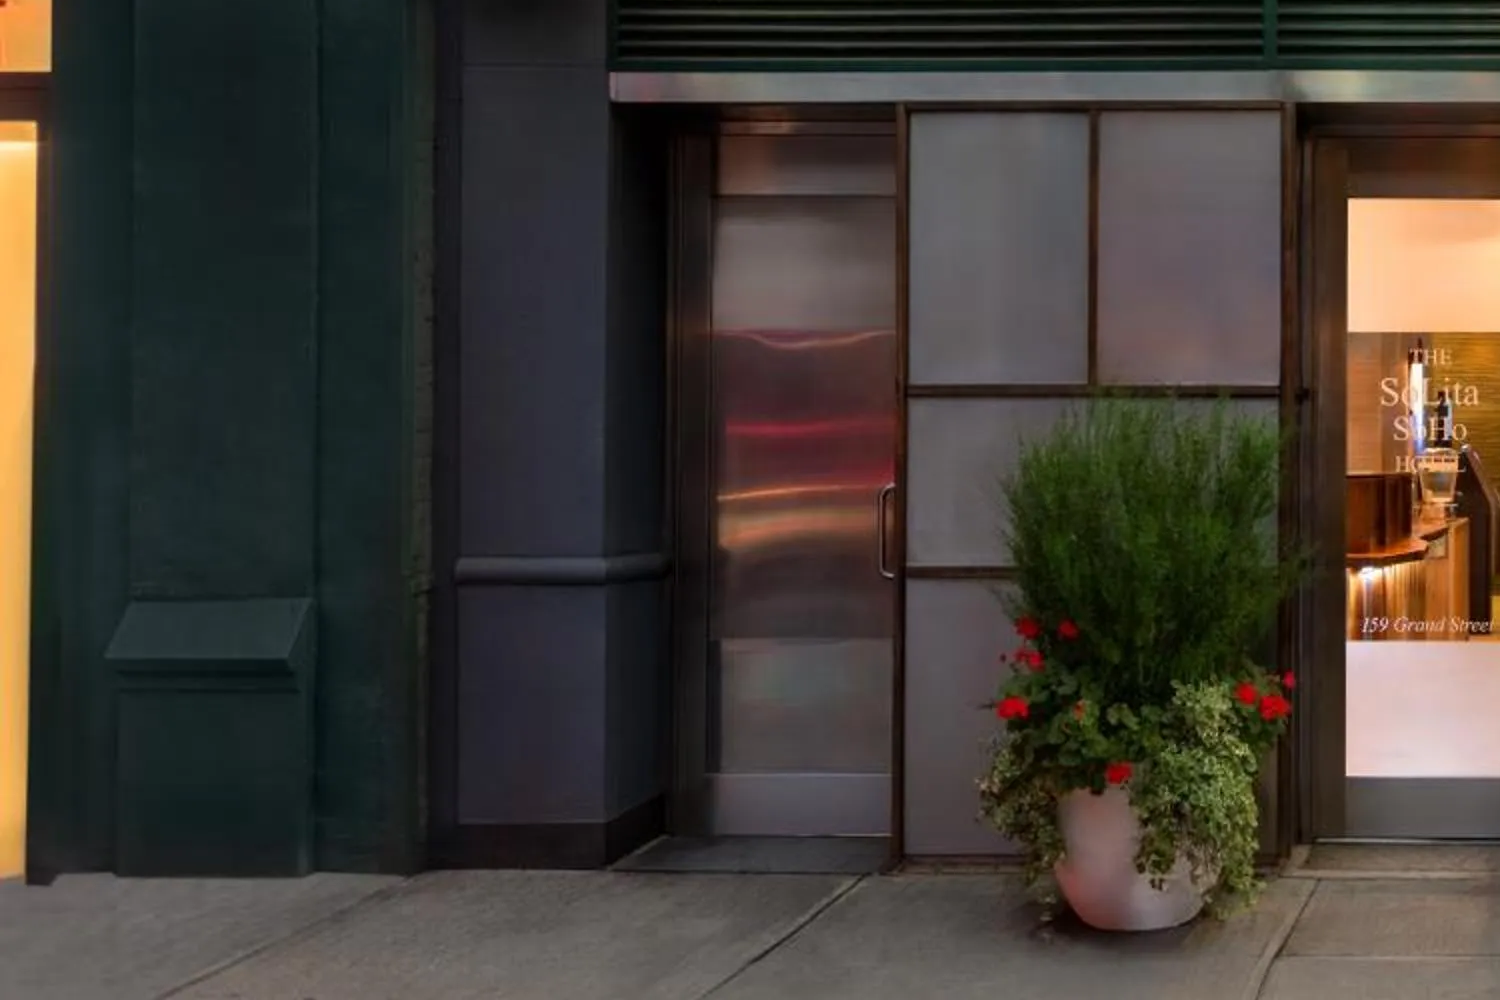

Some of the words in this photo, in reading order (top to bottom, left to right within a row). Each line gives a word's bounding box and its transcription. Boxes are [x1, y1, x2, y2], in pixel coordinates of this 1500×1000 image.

[1409, 348, 1453, 366] THE
[1360, 615, 1389, 633] 159
[1393, 614, 1447, 633] Grand
[1449, 615, 1496, 633] Street
